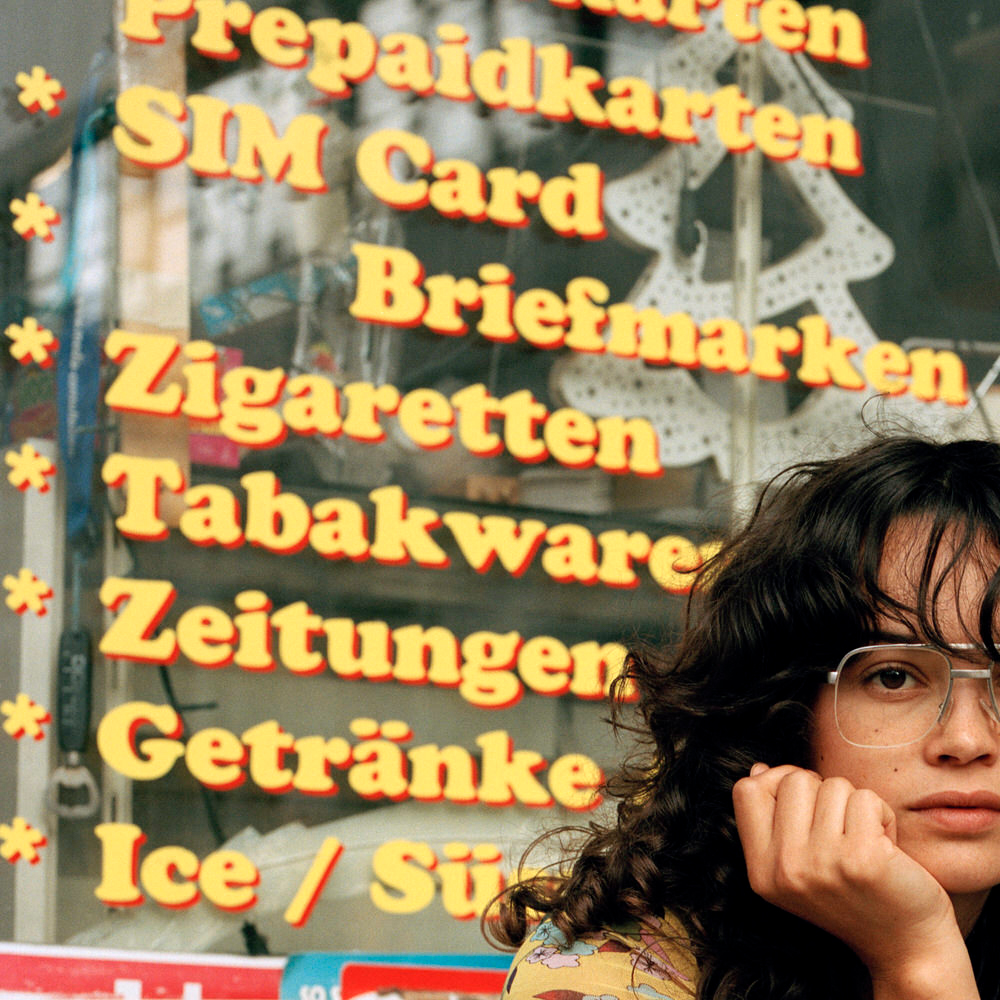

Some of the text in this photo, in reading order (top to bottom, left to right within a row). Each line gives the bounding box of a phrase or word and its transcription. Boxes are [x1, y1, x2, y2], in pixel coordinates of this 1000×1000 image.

[113, 85, 607, 238] SIM Card
[119, 0, 864, 176] Prepaidkarten
[349, 242, 970, 407] Briefmarken
[104, 329, 664, 478] Zigaretten
[99, 576, 641, 709] Zeitungen
[97, 701, 605, 811] Getränke
[94, 823, 260, 910] Ice
[284, 836, 344, 927] /
